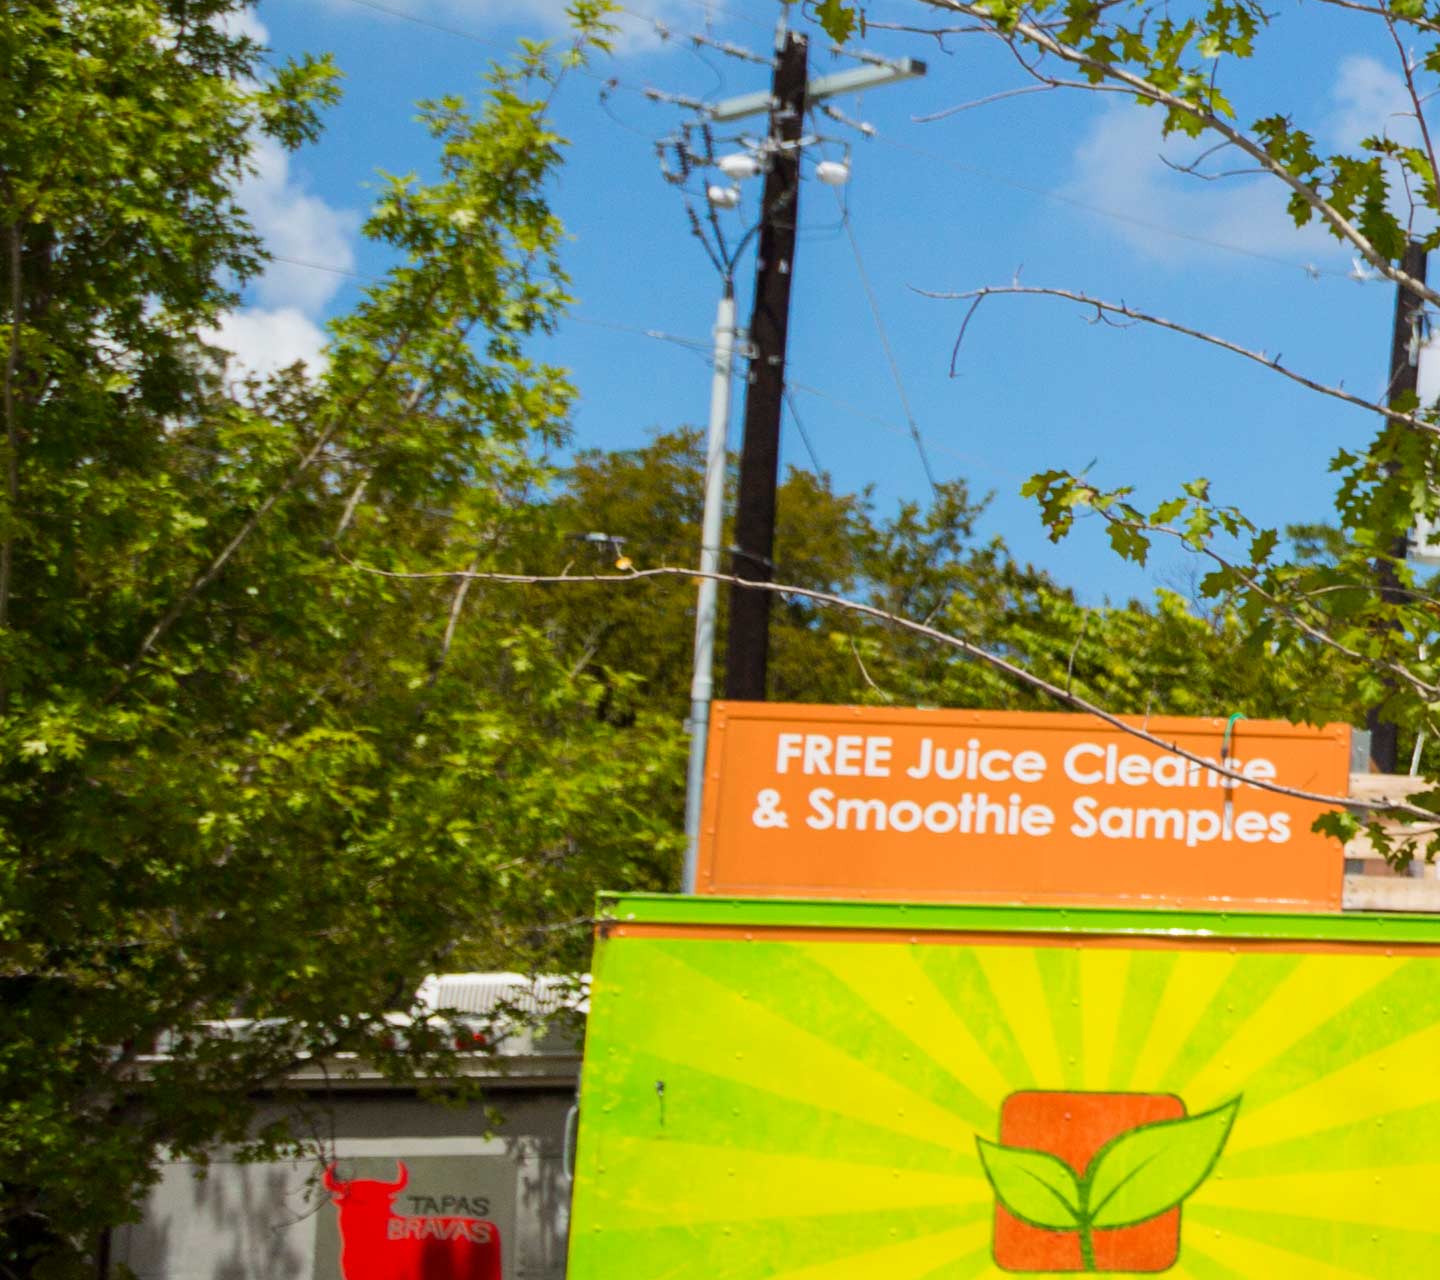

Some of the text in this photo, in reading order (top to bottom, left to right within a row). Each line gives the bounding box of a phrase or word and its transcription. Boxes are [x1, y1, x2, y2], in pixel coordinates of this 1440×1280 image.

[775, 733, 1278, 788] FREE Juice Cleanse
[752, 786, 1292, 848] & Smoothie Samples
[407, 1194, 491, 1216] TAPAS
[386, 1218, 493, 1244] BRAVAS
